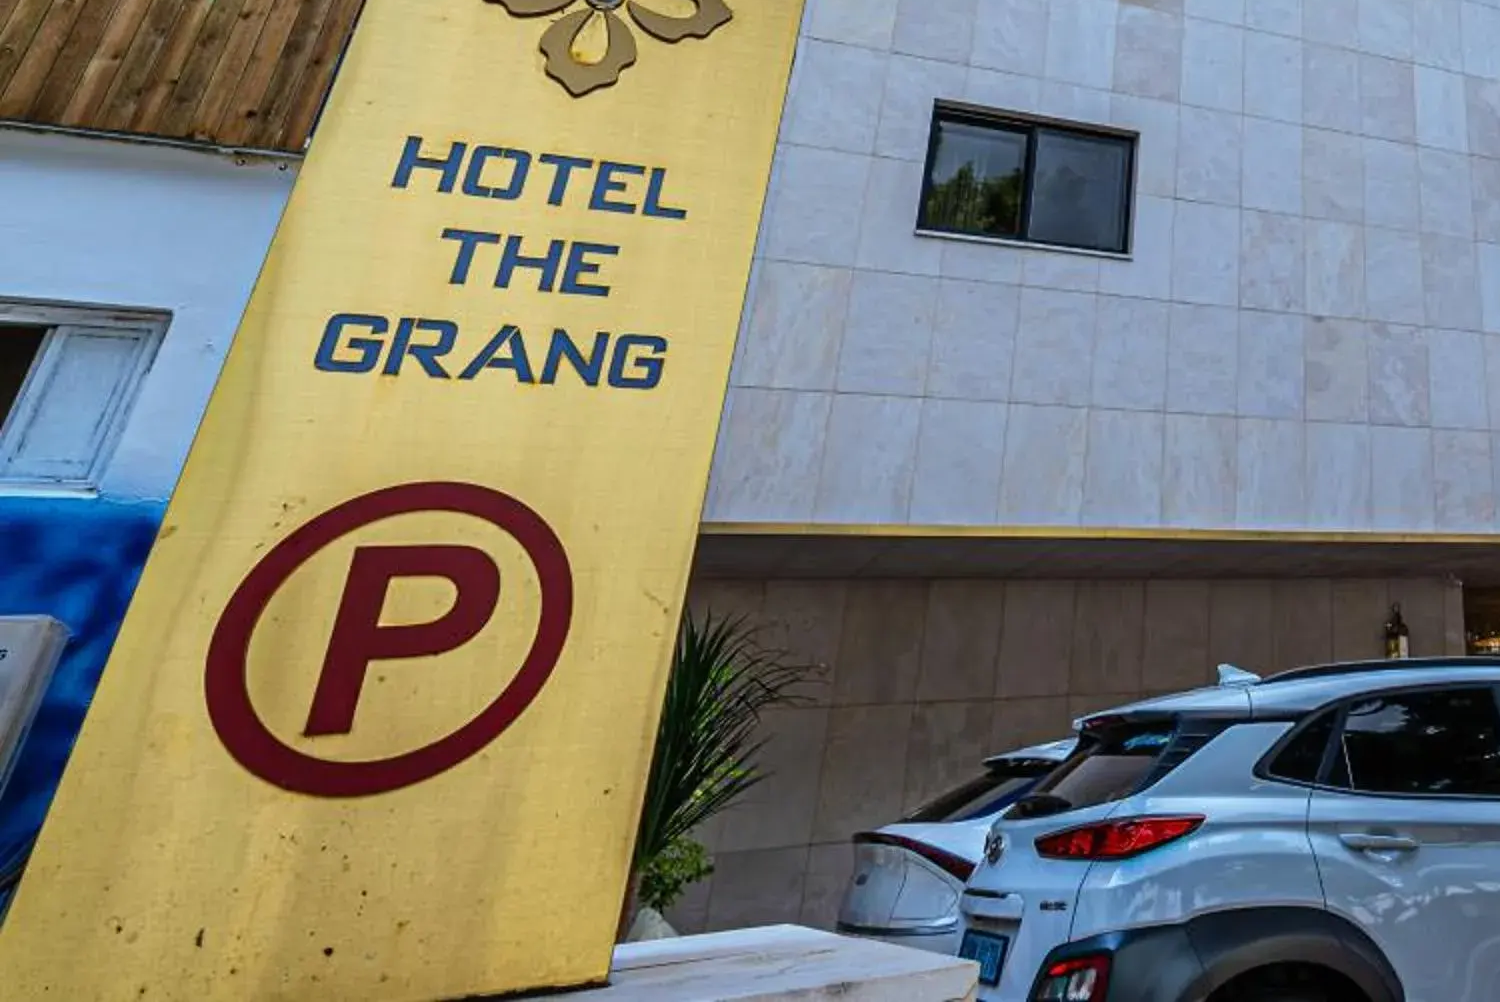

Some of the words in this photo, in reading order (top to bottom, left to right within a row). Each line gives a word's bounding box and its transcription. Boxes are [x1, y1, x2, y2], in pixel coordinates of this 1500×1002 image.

[391, 135, 687, 219] HOTEL
[441, 228, 620, 297] THE
[314, 313, 668, 389] GRANG
[303, 544, 501, 737] P
